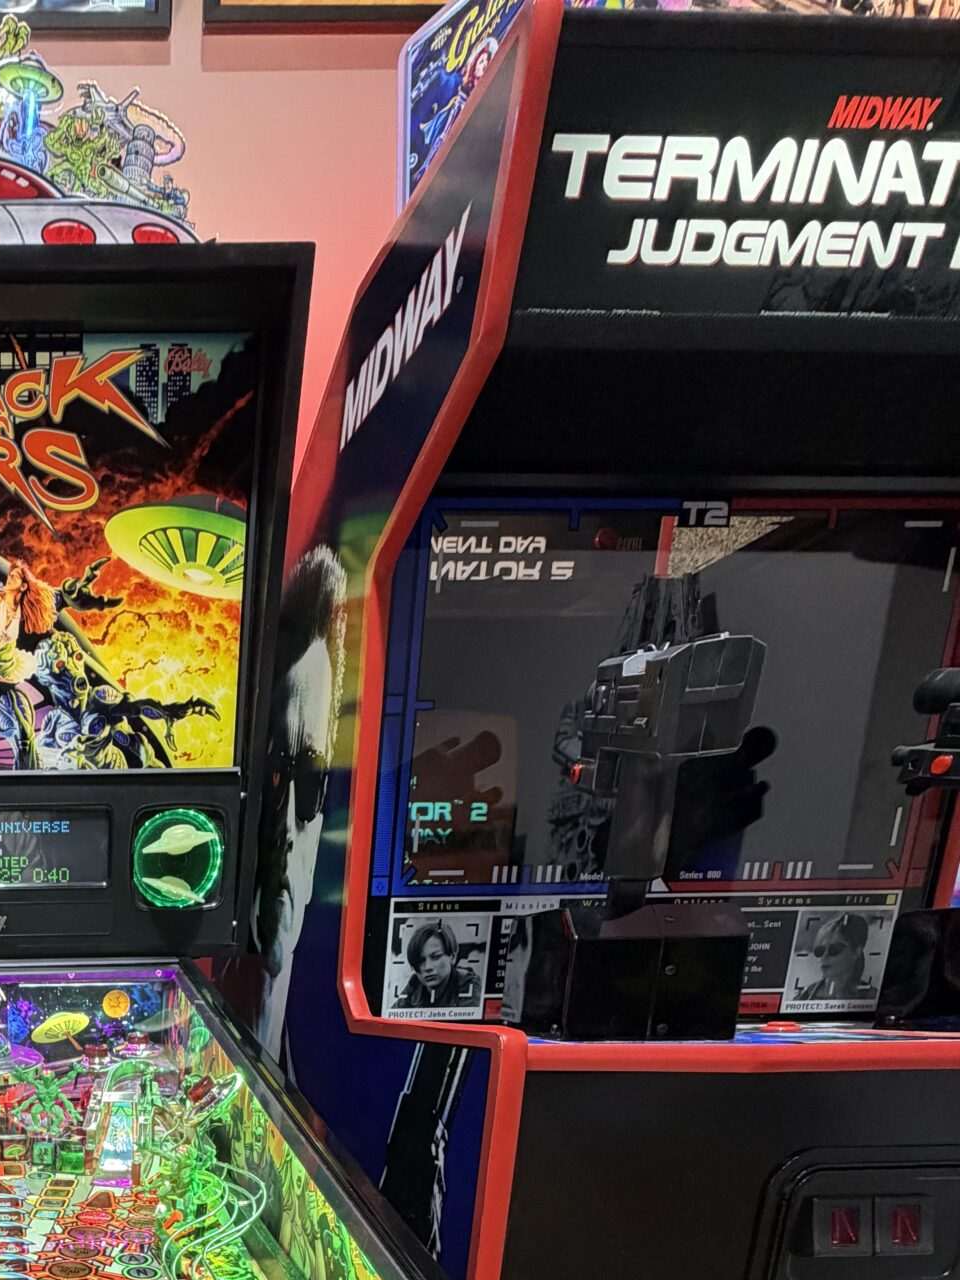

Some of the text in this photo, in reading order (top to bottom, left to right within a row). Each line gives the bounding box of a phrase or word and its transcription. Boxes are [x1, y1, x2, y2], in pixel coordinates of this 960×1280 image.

[606, 218, 945, 270] JUDGMENT
[682, 501, 730, 526] T2
[470, 802, 488, 821] 2
[32, 867, 70, 884] 0:40
[417, 902, 460, 911] Status
